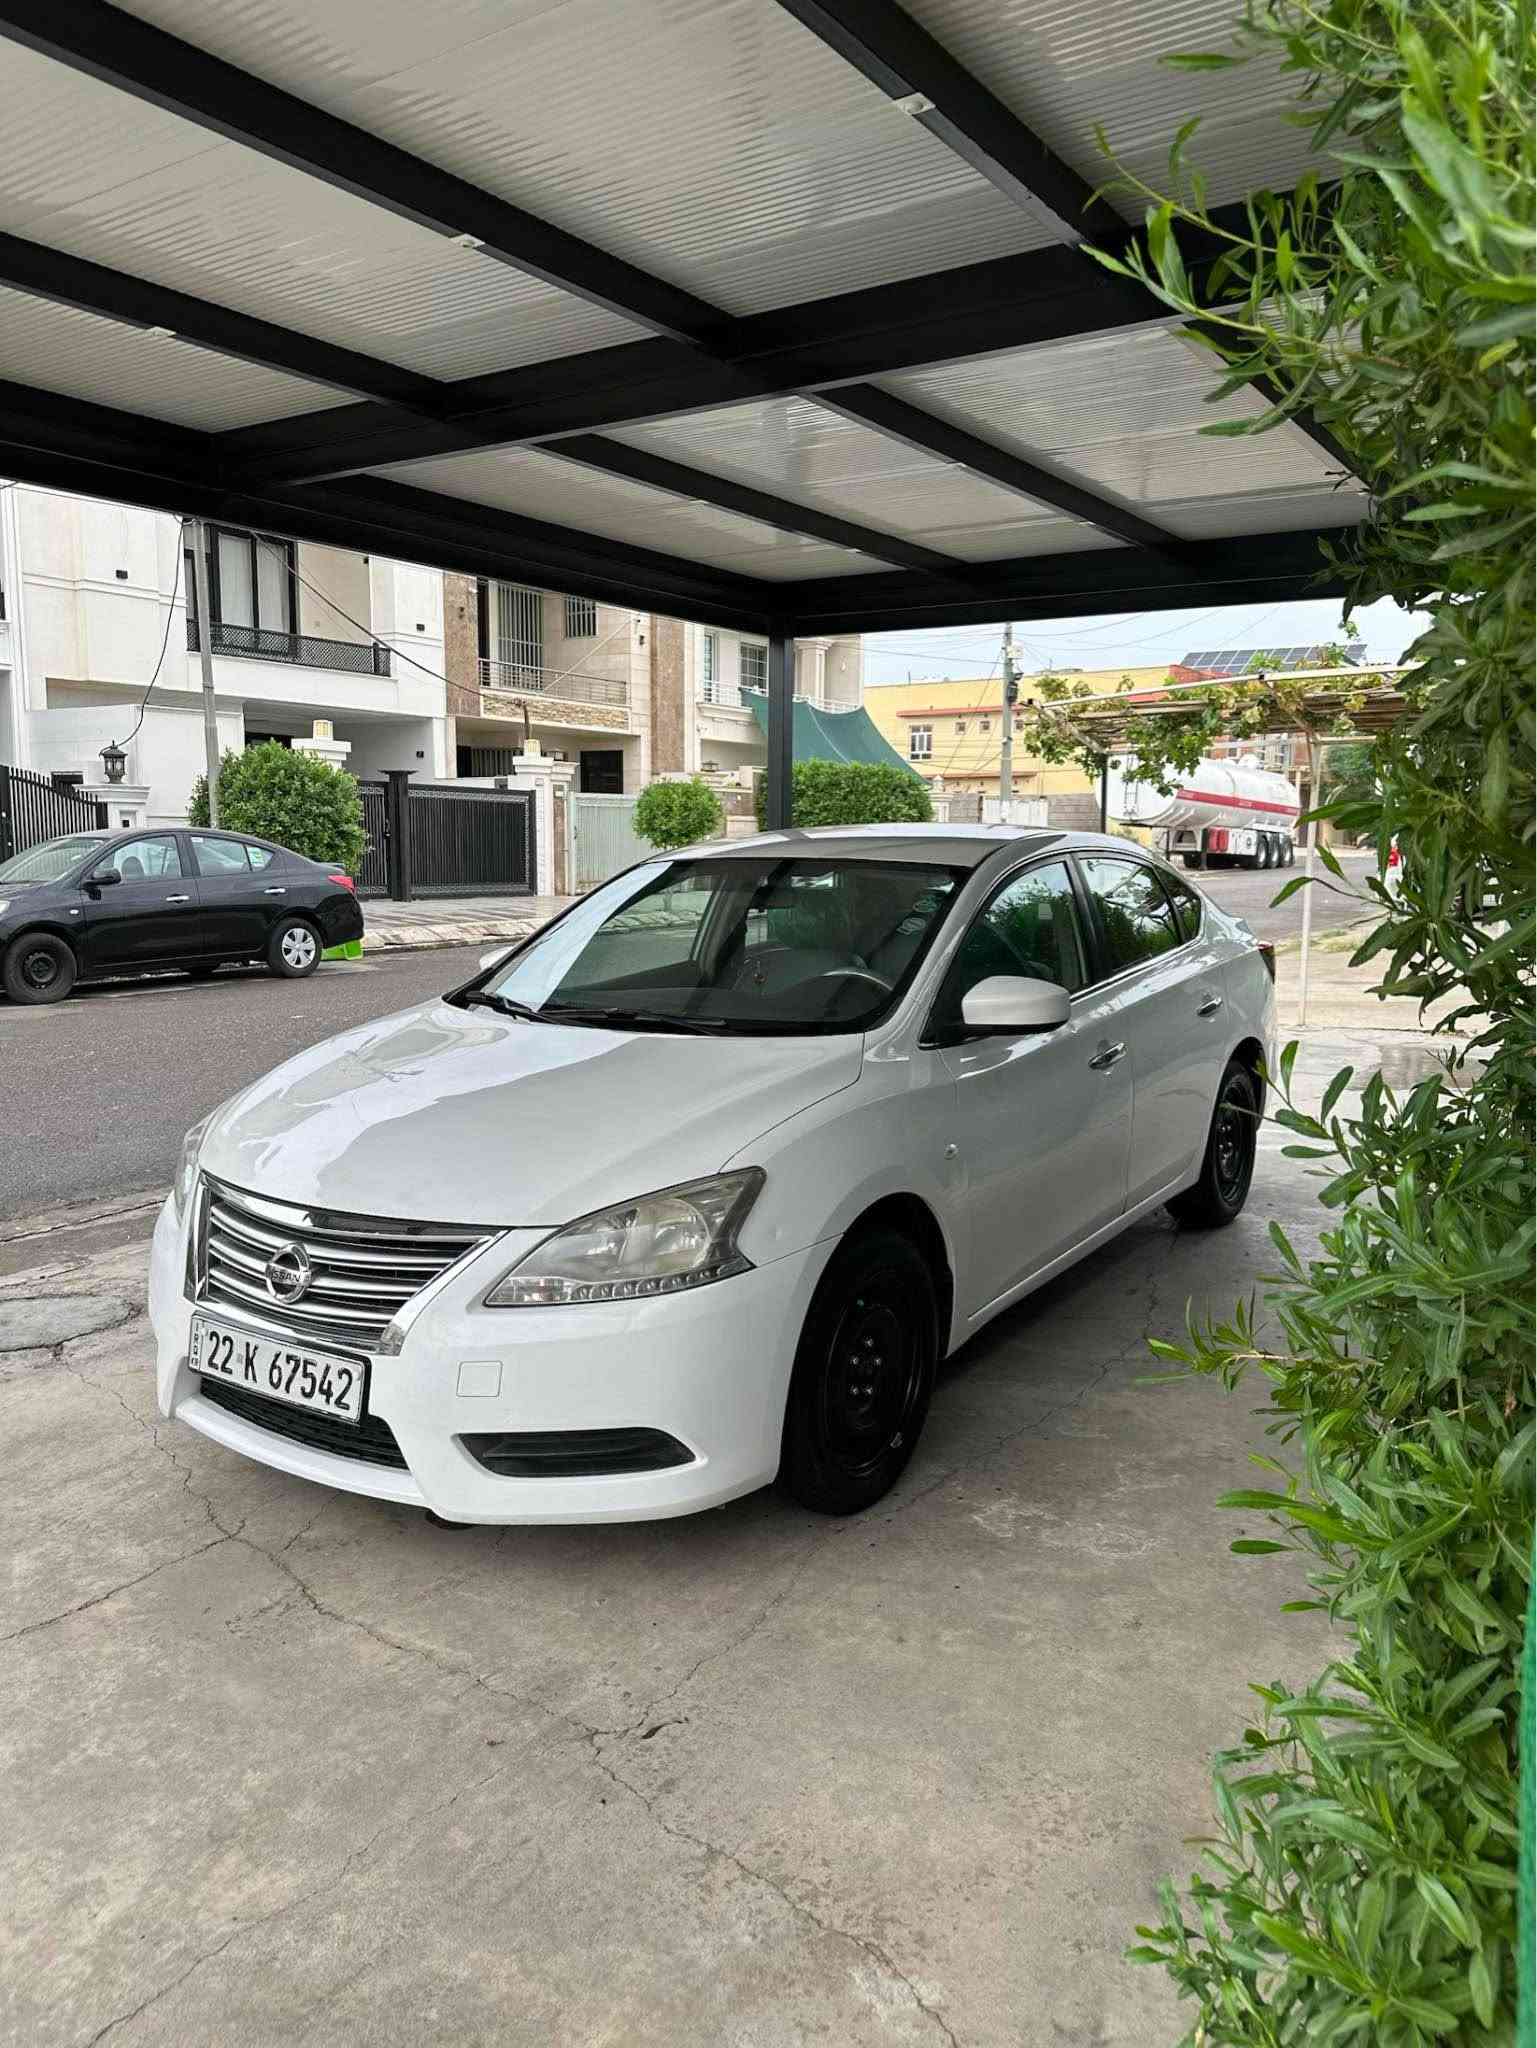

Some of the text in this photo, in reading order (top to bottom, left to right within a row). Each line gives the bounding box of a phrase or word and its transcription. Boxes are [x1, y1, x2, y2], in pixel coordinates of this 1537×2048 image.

[207, 1331, 353, 1410] 22 K 67542
